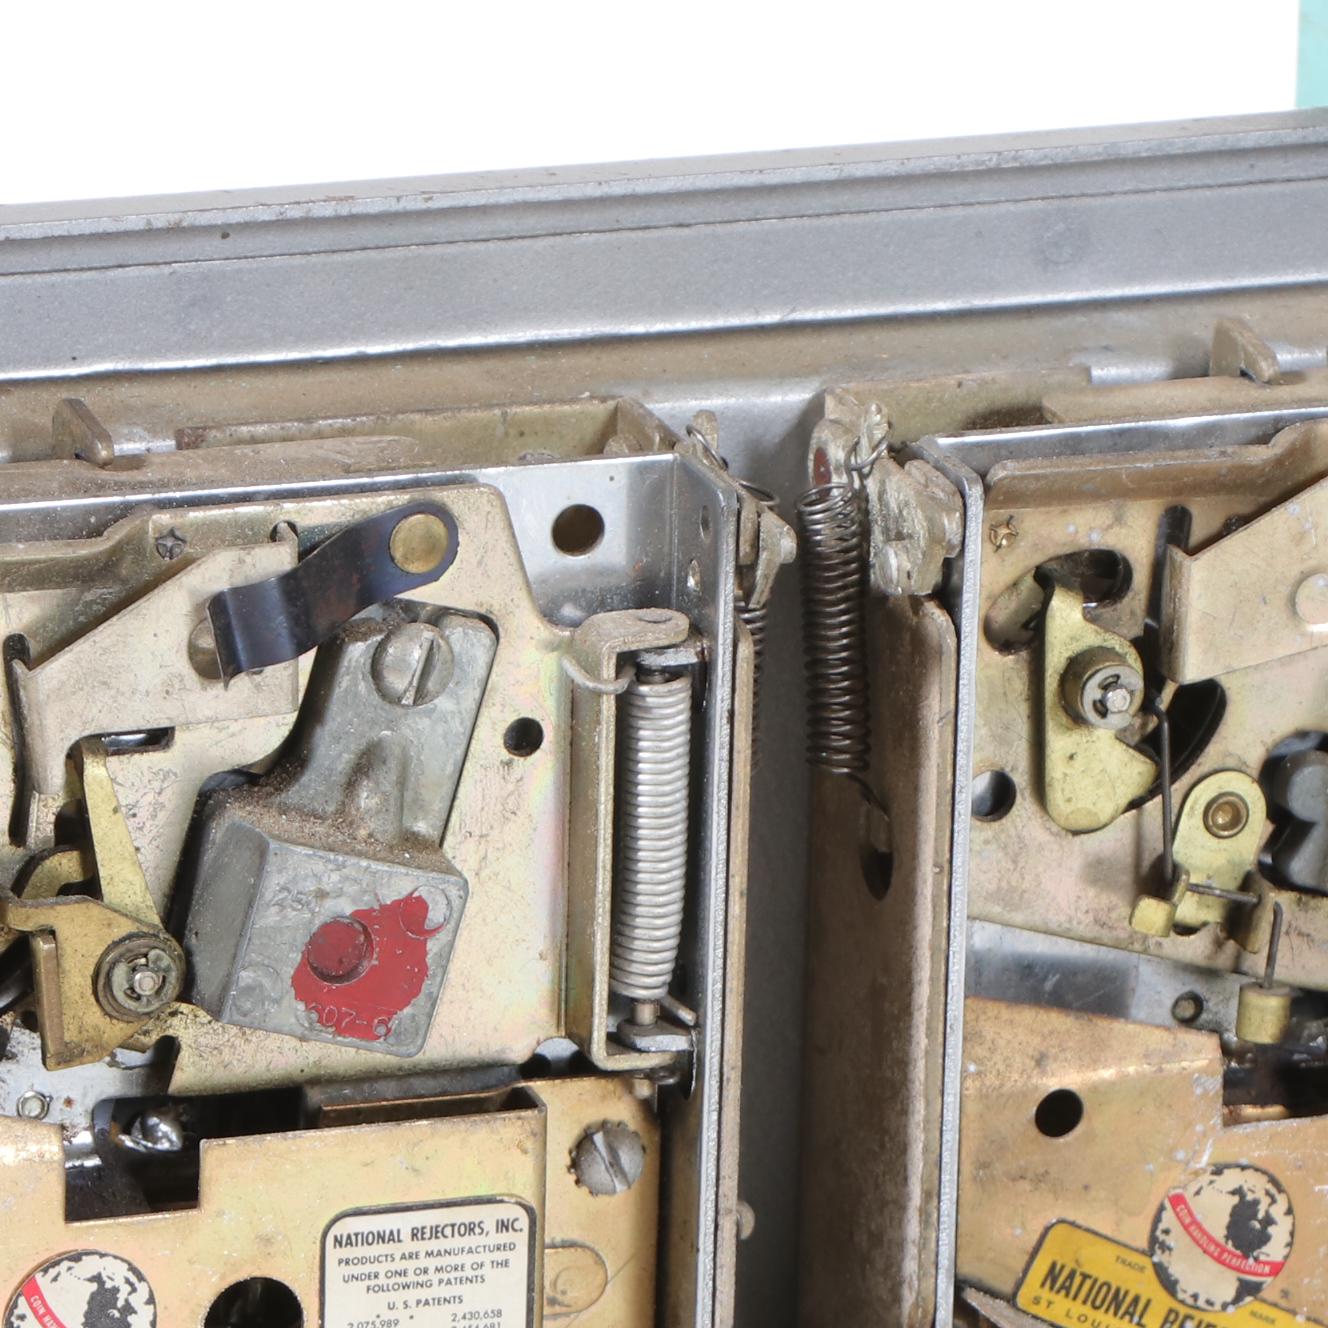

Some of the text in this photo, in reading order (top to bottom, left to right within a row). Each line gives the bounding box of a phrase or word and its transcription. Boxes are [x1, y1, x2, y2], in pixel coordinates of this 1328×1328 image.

[333, 1218, 523, 1249] NATIONAL REJECTORS, INC.
[338, 1242, 516, 1266] PRODUCTS ARE MANUFACTURED
[1116, 1255, 1147, 1273] TRADE
[343, 1259, 510, 1283] UNDER ONE OR MORE OF THE
[367, 1275, 485, 1294] FOLLOWING PATENTS
[1040, 1260, 1152, 1328] NATIONAL
[31, 1295, 46, 1315] COIN
[388, 1295, 463, 1310] U. S. PATENTS
[451, 1309, 502, 1322] 2,430,658
